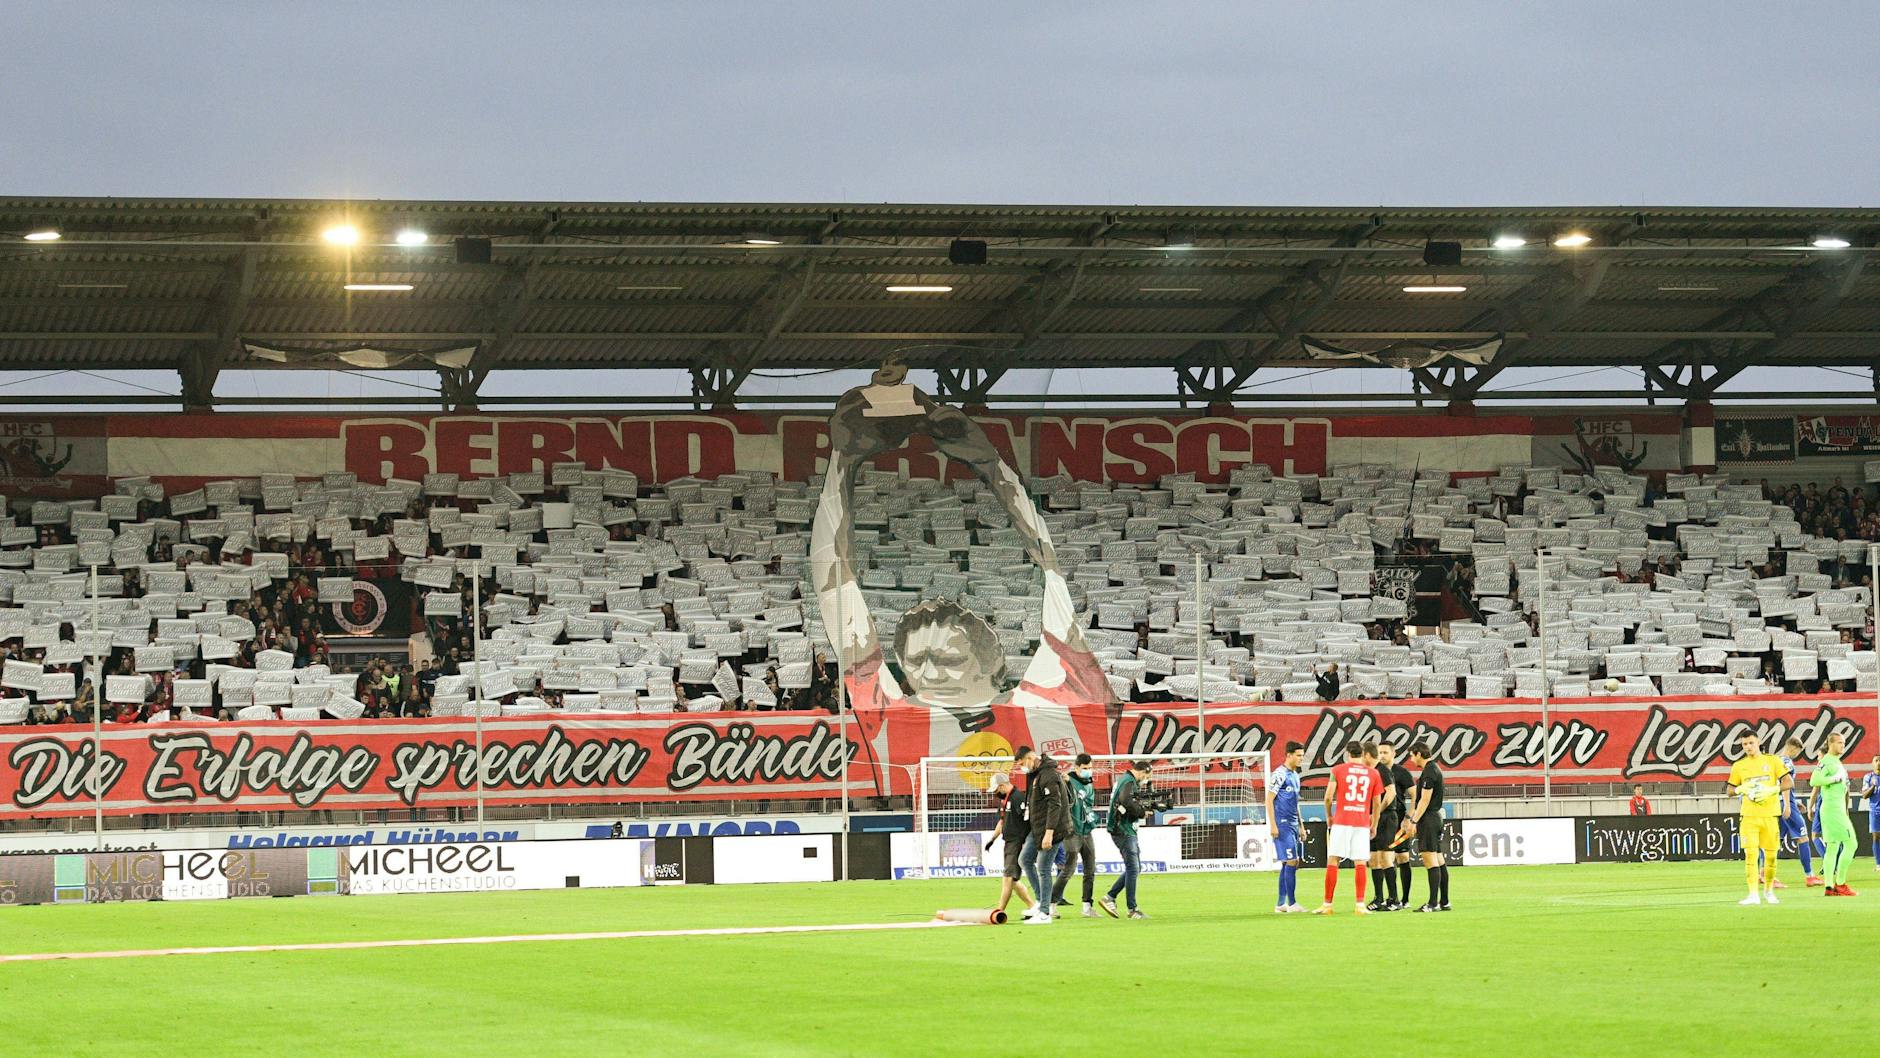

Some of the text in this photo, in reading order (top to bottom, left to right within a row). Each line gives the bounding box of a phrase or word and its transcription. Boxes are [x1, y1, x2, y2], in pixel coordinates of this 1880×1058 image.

[1589, 422, 1623, 433] HFC
[343, 418, 737, 484] BERND
[1047, 741, 1068, 750] HFC
[1129, 705, 1865, 780] Vom Libero zur Legende
[10, 722, 856, 806] Die Erfolge sprechen Bände
[1345, 774, 1370, 802] 33
[1286, 849, 1293, 859] 5
[943, 857, 978, 868] HWG
[1110, 862, 1158, 873] UON
[929, 867, 976, 877] UNION
[88, 885, 123, 900] DAS
